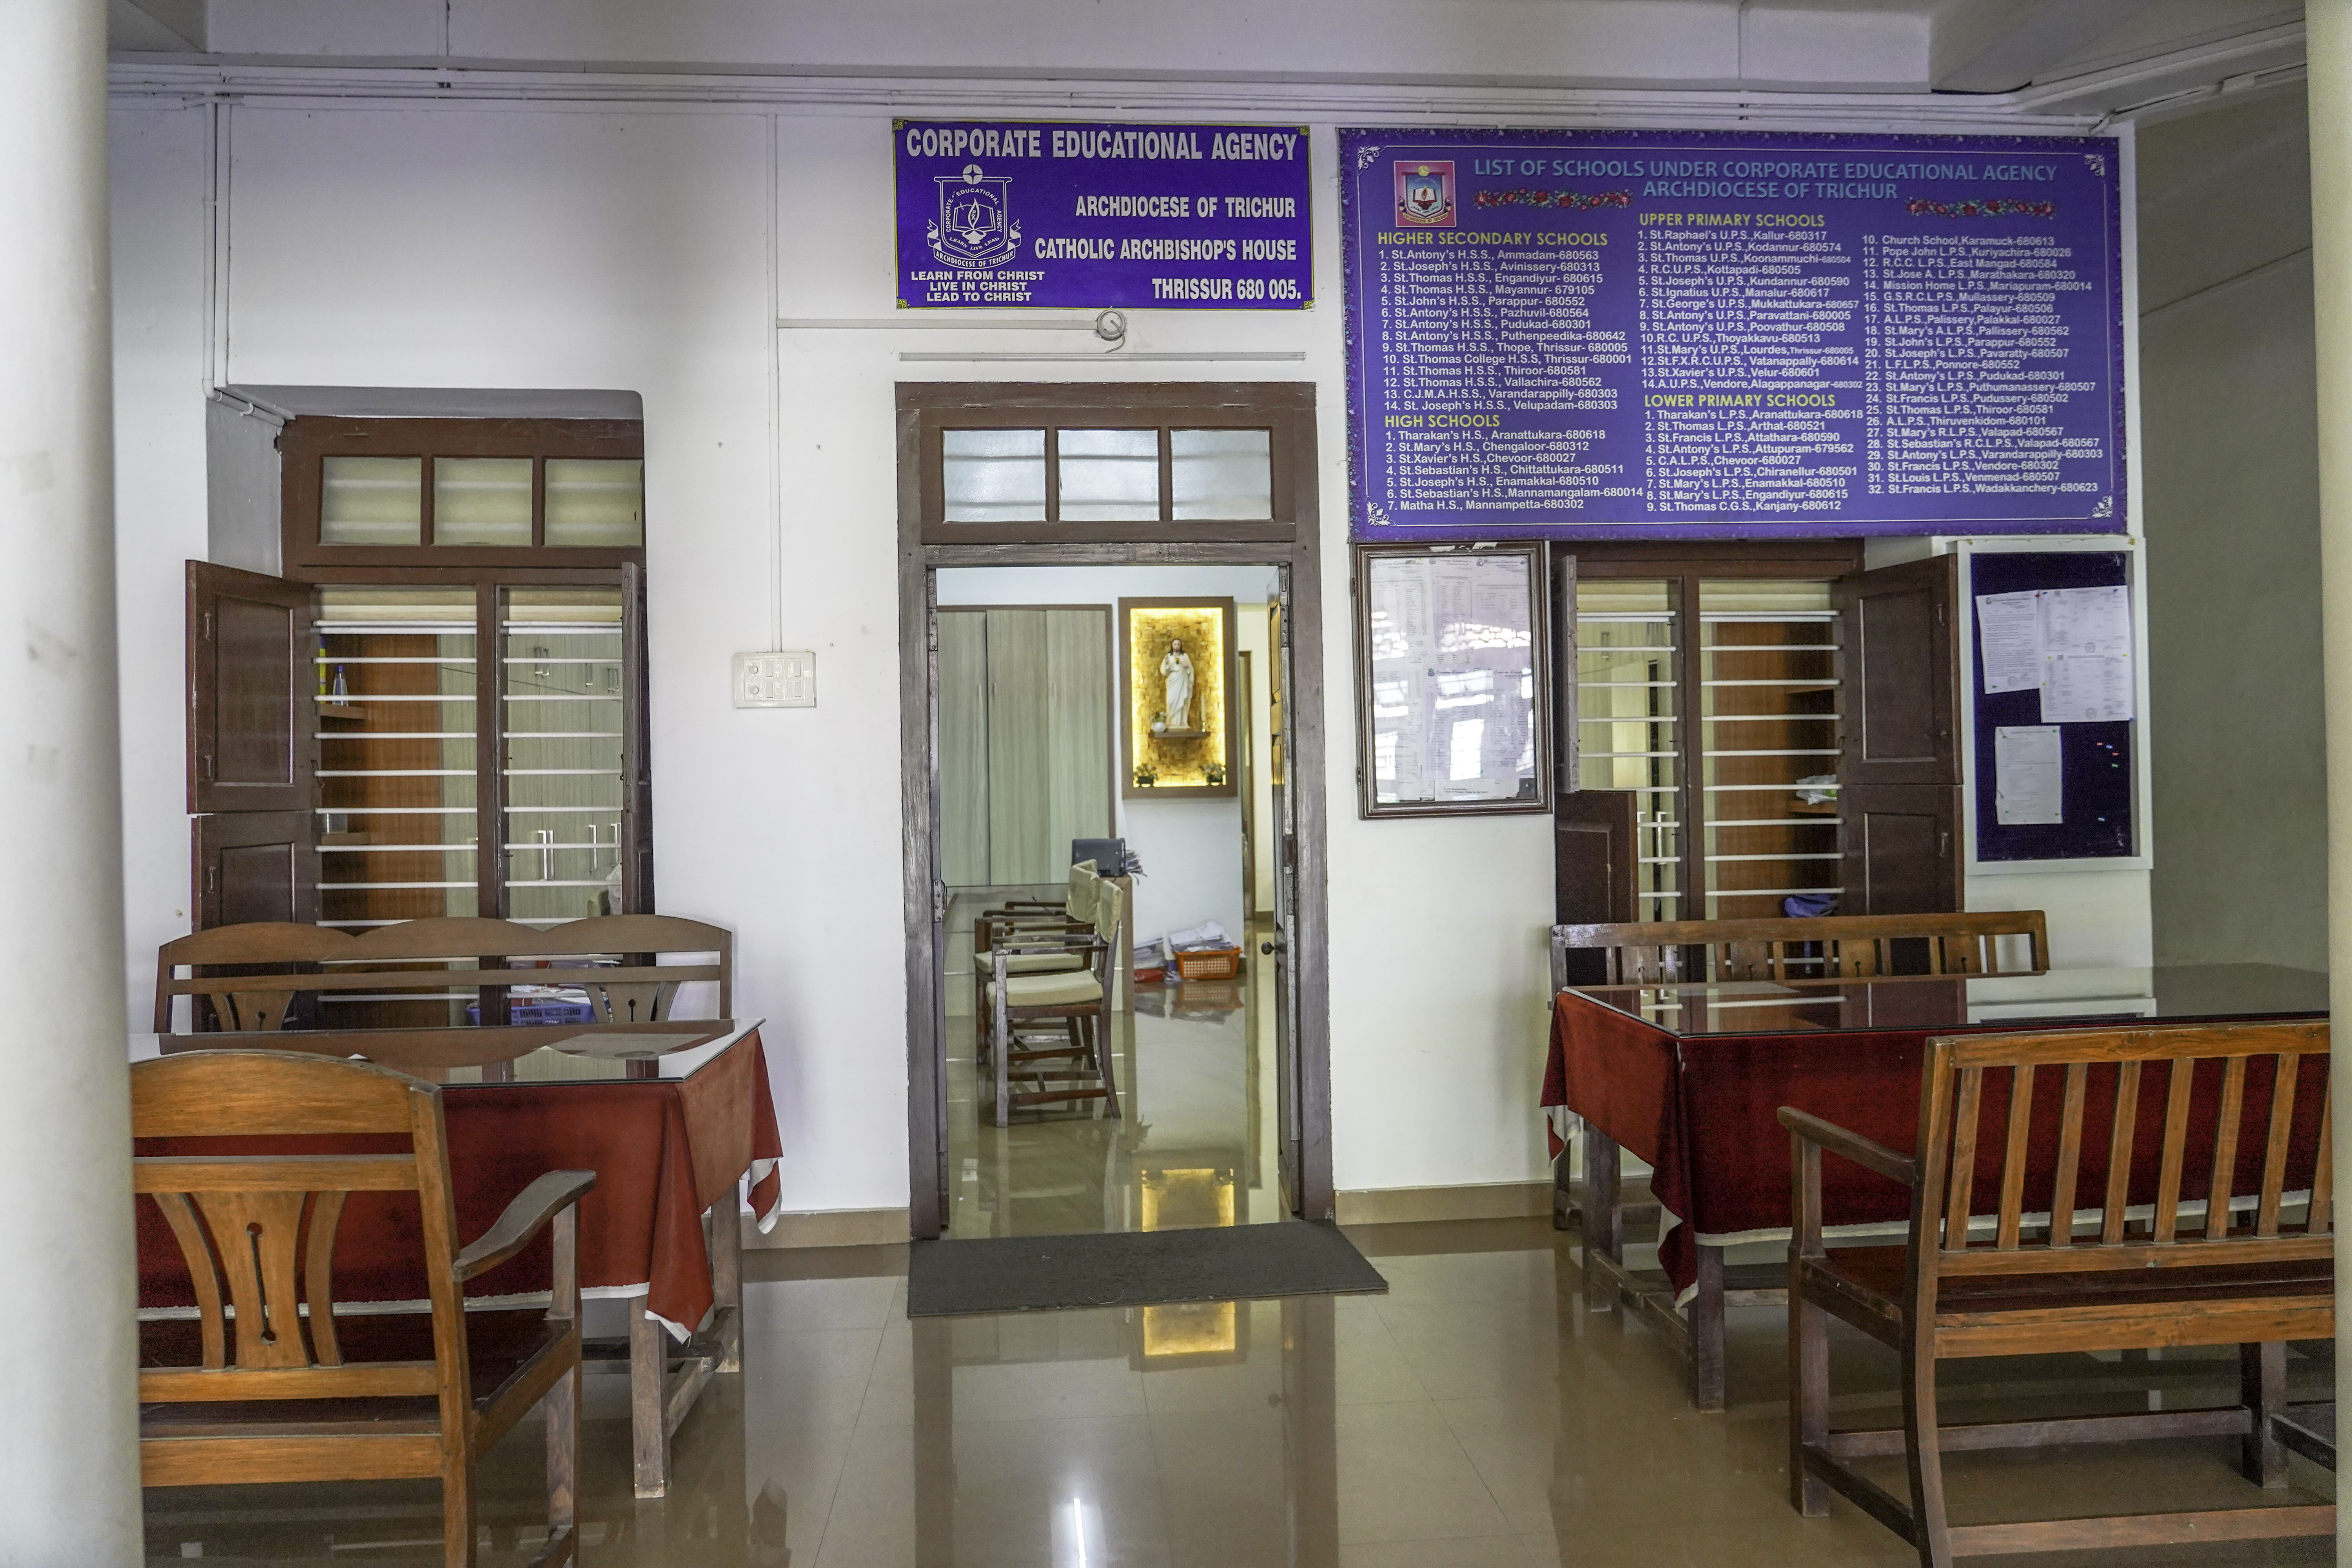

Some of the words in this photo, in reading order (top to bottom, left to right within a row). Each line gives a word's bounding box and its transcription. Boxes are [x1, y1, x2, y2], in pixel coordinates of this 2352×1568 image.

[907, 129, 1041, 158] CORPORATE
[1053, 130, 1203, 160] EDUCATIONAL
[1211, 132, 1297, 160] AGENCY
[1475, 159, 1515, 175] LIST
[1521, 160, 1547, 176] OF
[1552, 160, 1644, 176] SCHOOLS
[1650, 161, 1718, 177] UNDER
[1723, 161, 1839, 178] CORPORATE
[1845, 163, 1978, 180] EDUCATIONAL
[1982, 165, 2057, 181] AGENCY
[1642, 181, 1779, 198] ARCHDIOCESE
[1784, 182, 1810, 198] OF
[1814, 183, 1898, 199] TRICHUR
[945, 198, 954, 232] CORPORATE
[956, 188, 1000, 205] EDUCATIONAL
[1076, 196, 1190, 218] ARCHDIOCESE
[1197, 196, 1218, 218] OF
[1225, 197, 1296, 218] TRICHUR
[1640, 213, 1682, 226] UPPER
[1688, 213, 1751, 226] PRIMARY
[1756, 214, 1825, 227] SCHOOLS
[949, 236, 968, 248] LEARN
[984, 237, 1000, 247] LEAD
[1378, 232, 1434, 245] HIGHER
[1438, 232, 1532, 245] SECONDARY
[1537, 232, 1608, 246] SCHOOLS
[1862, 235, 1878, 244] 10.
[1035, 238, 1114, 260] CATHOLIC
[1120, 239, 1236, 260] ARCHBISHOP'S
[1242, 239, 1296, 261] HOUSE
[935, 251, 976, 267] ARCHDIOCESE
[989, 250, 1014, 265] TRICHUR
[1638, 264, 1648, 274] 4.
[911, 271, 953, 281] LEARN
[957, 270, 993, 280] FROM
[997, 270, 1045, 280] CHRIST
[1381, 272, 1391, 283] 3.
[1394, 272, 1452, 283] St.Thomas
[1455, 272, 1492, 284] H.S.S.,
[1495, 273, 1561, 285] Engandiyur-
[1563, 273, 1603, 283] 680615
[930, 281, 958, 291] LIVE
[962, 281, 975, 291] IN
[980, 281, 1027, 291] CHRIST
[1152, 278, 1232, 299] THRISSUR
[1236, 279, 1265, 299] 680
[1269, 279, 1301, 299] 005.
[1380, 284, 1391, 294] 4.
[1394, 284, 1453, 294] St.Thomas
[1455, 284, 1492, 295] H.S.S.,
[1495, 285, 1552, 296] Mayannur-
[1555, 285, 1595, 295] 679105
[927, 292, 959, 302] LEAD
[963, 292, 980, 302] TO
[984, 292, 1032, 302] CHRIST
[1639, 287, 1649, 297] 6.
[1651, 287, 1709, 300] St.Ignatius
[1864, 303, 1880, 312] 16.
[1639, 310, 1649, 320] 8.
[1639, 321, 1650, 331] 9.
[1640, 333, 1679, 343] 10.R.C.
[1382, 342, 1393, 352] 9.
[1396, 342, 1454, 352] St.Thomas
[1457, 342, 1494, 353] H.S.S.,
[1496, 342, 1534, 354] Thope,
[1536, 342, 1586, 352] Thrissur-
[1588, 342, 1628, 352] 680005
[1383, 354, 1399, 364] 10.
[1403, 354, 1461, 364] St.Thomas
[1464, 354, 1505, 366] College
[1508, 354, 1541, 365] H.S.S,
[1544, 354, 1631, 364] Thrissur-680001
[1749, 356, 1859, 368] Vatanappally-680614
[1865, 359, 1881, 369] 21.
[1383, 366, 1400, 376] 11.
[1403, 365, 1462, 376] St.Thomas
[1465, 365, 1501, 376] H.S.S.,
[1503, 365, 1586, 375] Thiroor-680581
[1383, 377, 1400, 387] 12.
[1403, 377, 1462, 387] St.Thomas
[1465, 377, 1501, 388] H.S.S.,
[1504, 377, 1602, 387] Vallachira-680562
[1383, 389, 1401, 399] 13.
[1403, 388, 1486, 399] C.J.M.A.H.S.S.,
[1488, 388, 1618, 401] Varandarappilly-680303
[1644, 394, 1694, 407] LOWER
[1699, 394, 1762, 407] PRIMARY
[1767, 394, 1835, 407] SCHOOLS
[1866, 394, 1882, 403] 24.
[1866, 405, 1882, 414] 25.
[1385, 415, 1423, 428] HIGH
[1428, 414, 1500, 428] SCHOOLS
[1645, 421, 1655, 431] 2.
[1657, 421, 1715, 431] St.Thomas
[1385, 430, 1396, 440] 1.
[1462, 430, 1488, 441] H.S.,
[1491, 429, 1606, 439] Aranattukara-680618
[1645, 433, 1655, 443] 3.
[1657, 433, 1712, 443] St.Francis
[1386, 454, 1396, 464] 3.
[1461, 452, 1576, 464] H.S.,Chevoor-680027
[1646, 456, 1656, 466] 5.
[1386, 465, 1397, 475] 4.
[1481, 465, 1507, 476] H.S.,
[1510, 464, 1623, 474] Chittattukara-680511
[1867, 461, 1884, 472] 30.
[1646, 479, 1657, 488] 7.
[1867, 473, 1884, 483] 31.
[1868, 484, 1885, 494] 32.
[1387, 501, 1397, 510] 7.
[1400, 500, 1434, 510] Matha
[1437, 500, 1463, 511] H.S.,
[1466, 499, 1584, 511] Mannampetta-680302
[1646, 502, 1657, 512] 9.
[1659, 502, 1717, 512] St.Thomas
